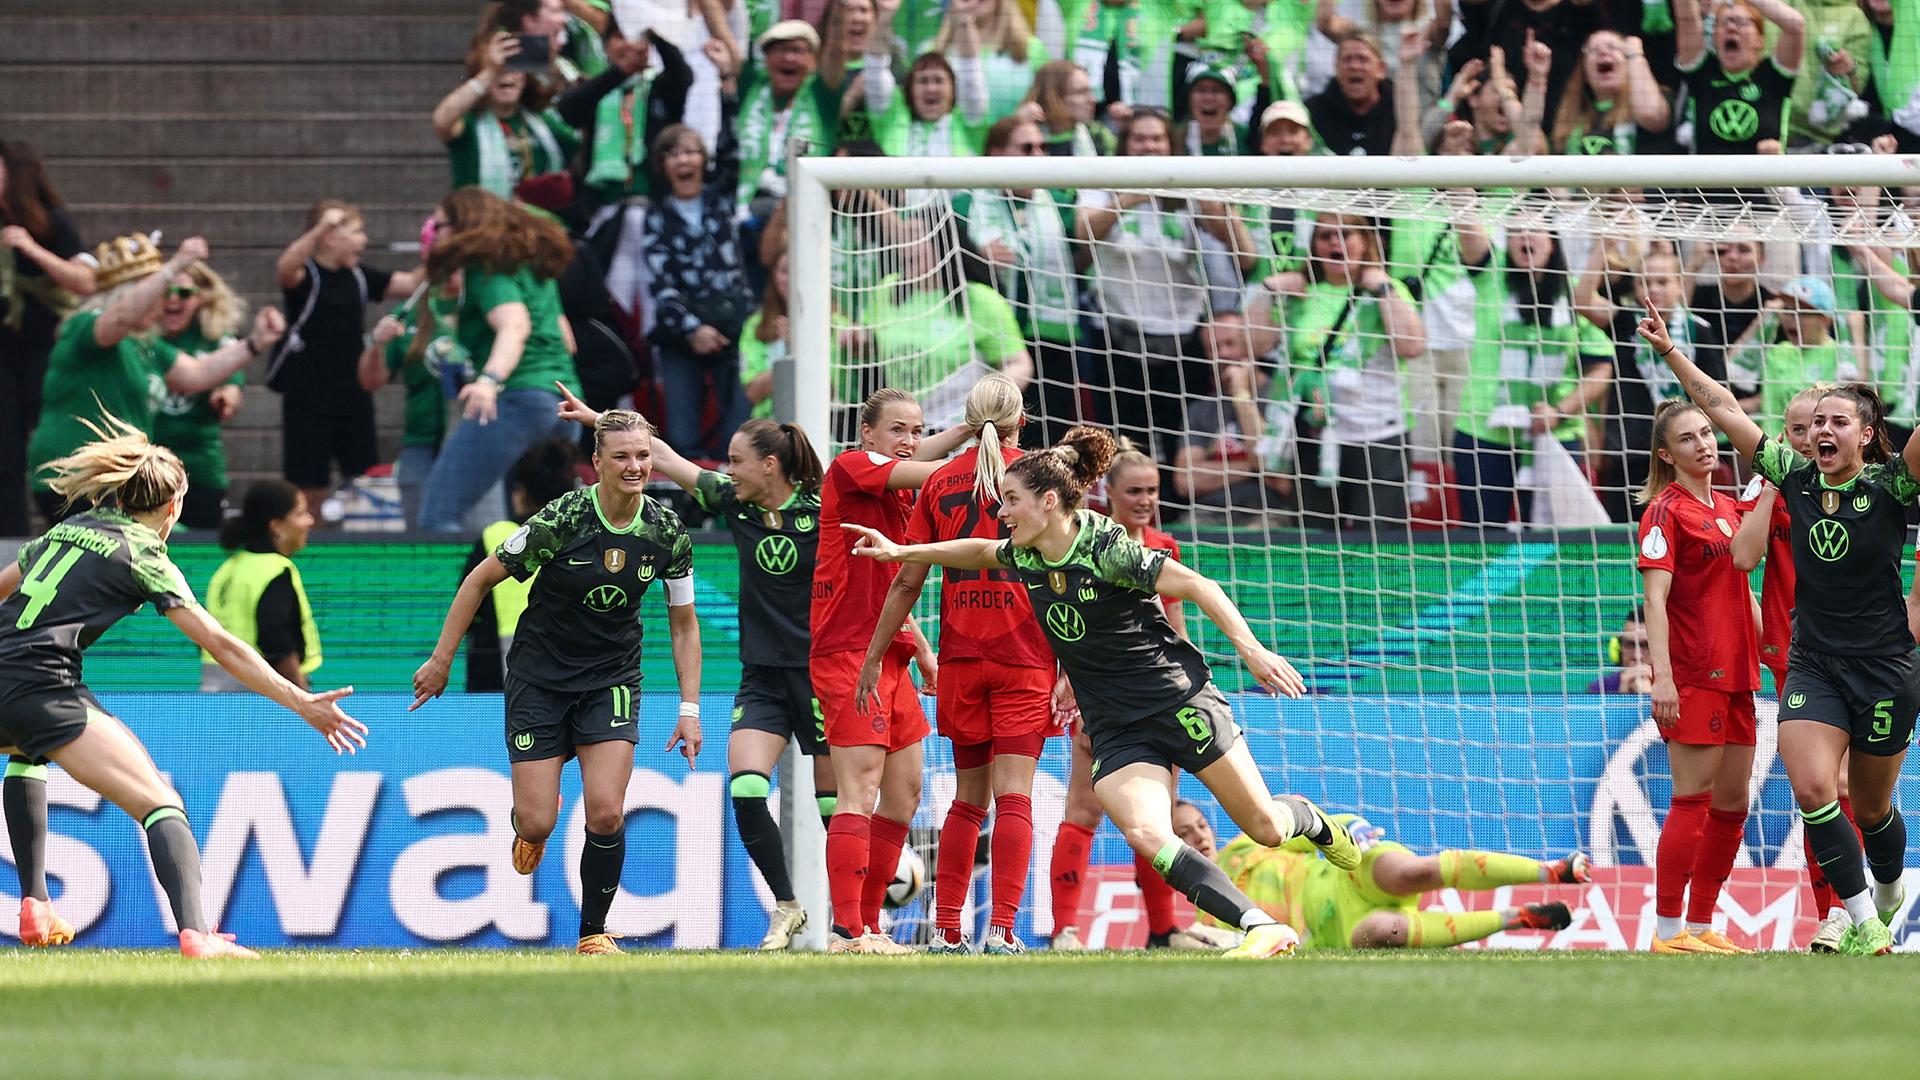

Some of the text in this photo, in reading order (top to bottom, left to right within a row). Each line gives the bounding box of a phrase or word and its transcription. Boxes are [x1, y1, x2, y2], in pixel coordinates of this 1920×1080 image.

[946, 471, 977, 487] BAYE
[755, 534, 798, 575] VW
[1808, 518, 1849, 562] VW
[15, 540, 85, 630] 4
[951, 589, 1015, 611] HARDER
[609, 685, 633, 720] 11
[1872, 699, 1895, 735] 5
[1175, 706, 1211, 742] 6
